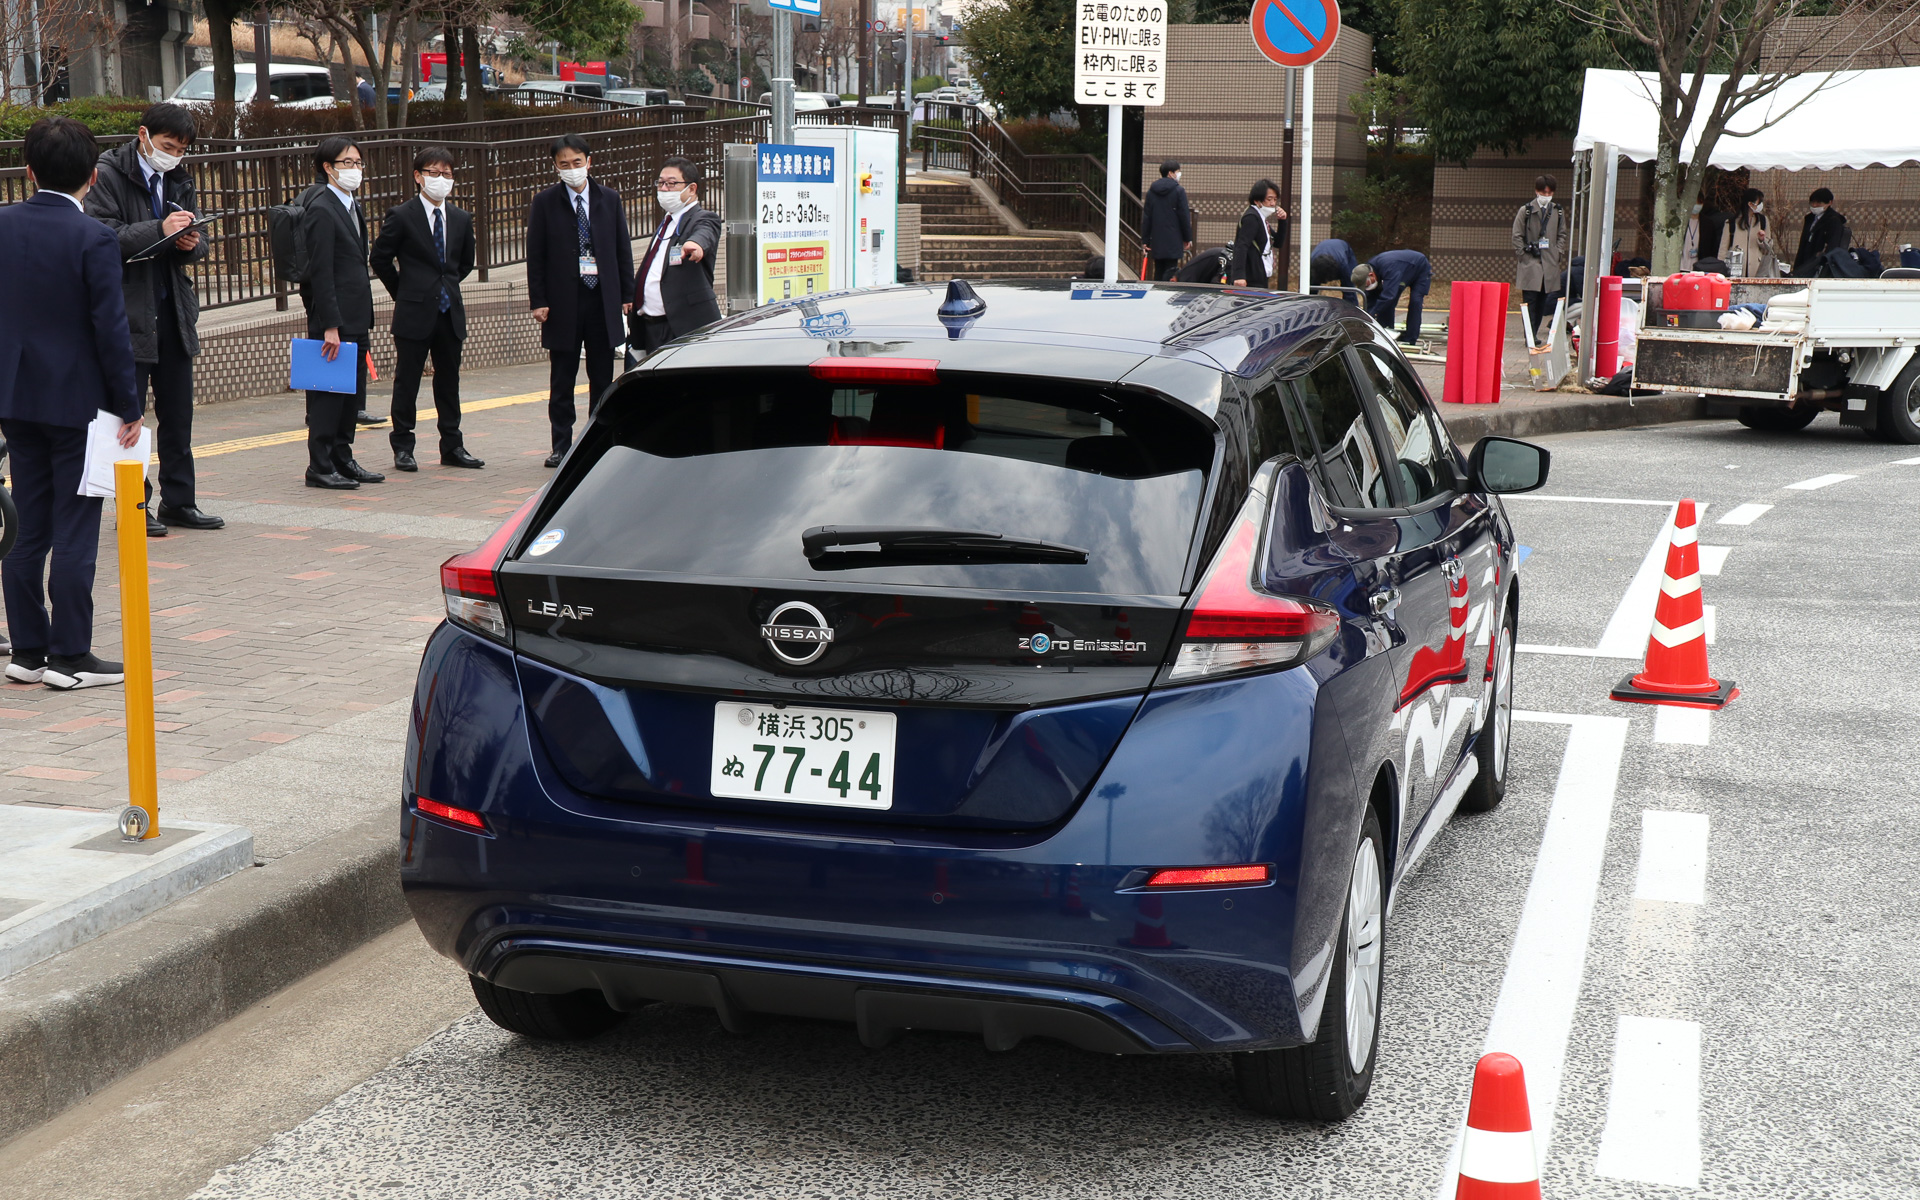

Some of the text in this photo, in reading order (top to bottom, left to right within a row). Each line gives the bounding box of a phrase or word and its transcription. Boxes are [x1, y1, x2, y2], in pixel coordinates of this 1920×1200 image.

[1082, 3, 1162, 23] 充電のための
[1083, 53, 1158, 73] 枠内に限る
[1085, 81, 1157, 99] ここまで
[761, 152, 831, 176] 社会実験実施中
[526, 598, 594, 621] LEAF
[761, 625, 833, 642] NISSAN
[1073, 639, 1147, 652] Emission
[757, 712, 854, 742] 横浜 305
[721, 744, 882, 801] ぬ 77-44
